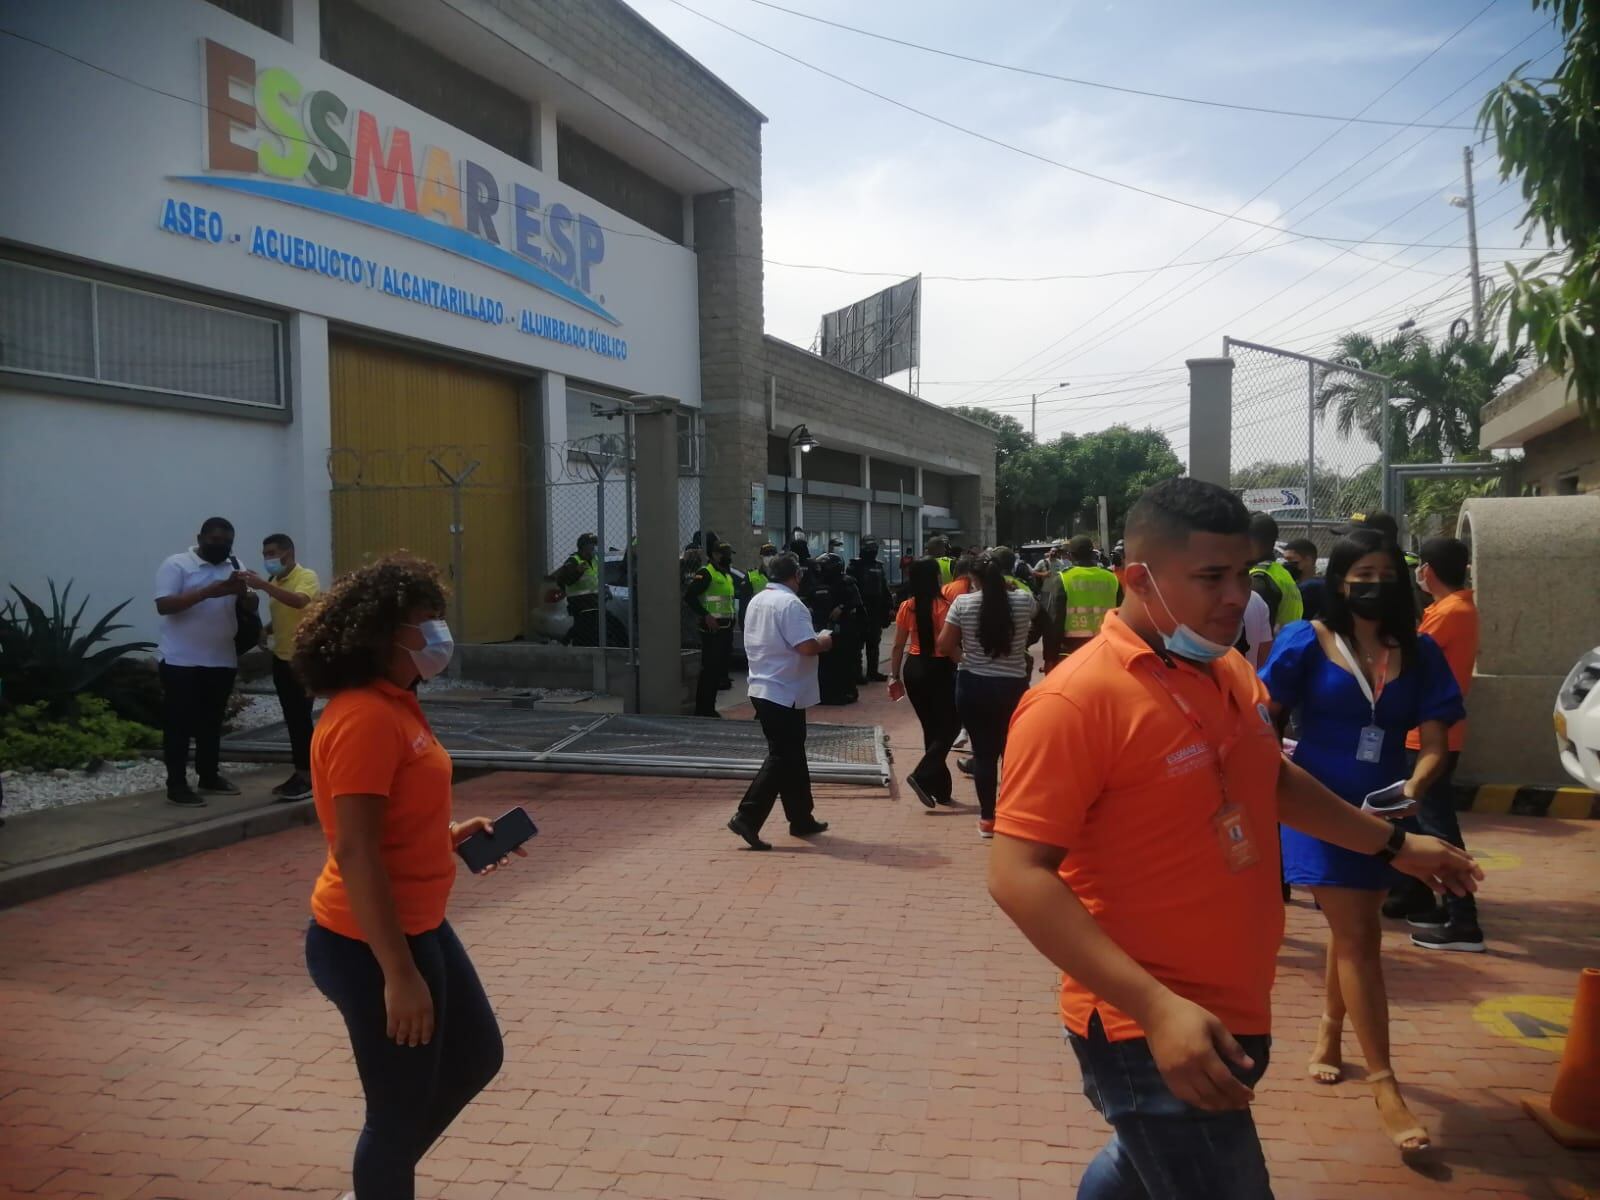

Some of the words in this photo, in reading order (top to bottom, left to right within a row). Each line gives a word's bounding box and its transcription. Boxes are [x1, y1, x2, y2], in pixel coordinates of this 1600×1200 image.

[203, 37, 501, 245] ESSMAR
[162, 198, 223, 243] ASEO
[252, 225, 363, 284] ACUEDUCTO
[366, 261, 378, 288] Y
[383, 265, 504, 326] ALCANTARILLADO
[521, 309, 586, 349] ALUMBRADO
[588, 327, 628, 361] PÚBLICO
